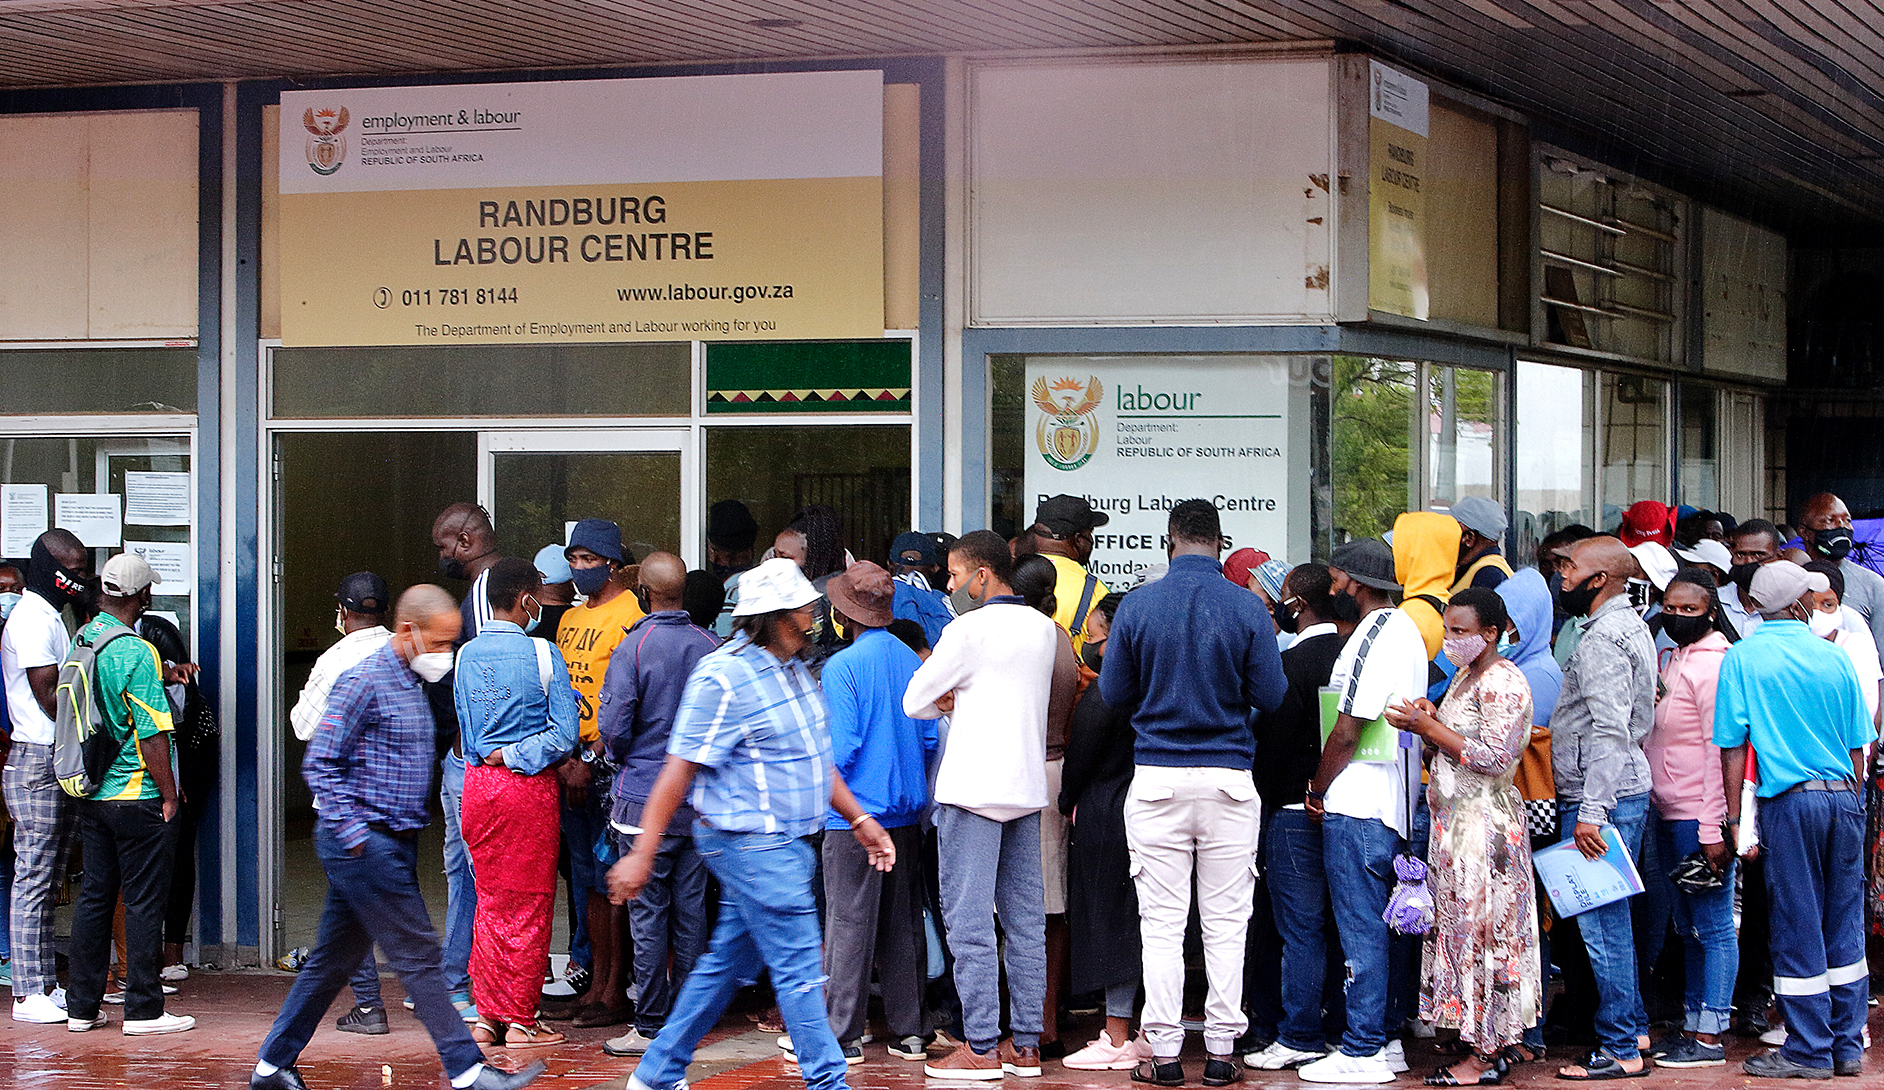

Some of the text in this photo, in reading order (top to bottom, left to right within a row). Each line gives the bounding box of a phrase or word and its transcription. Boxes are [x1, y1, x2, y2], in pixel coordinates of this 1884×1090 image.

[362, 109, 521, 131] employment & labour
[361, 145, 453, 156] Employment and Labour
[361, 154, 485, 166] REPUBLIC OF SOUTH AFRICA
[479, 195, 667, 229] RANDBURG
[433, 232, 715, 266] LABOUR CENTRE
[402, 286, 519, 306] 011 781 8144
[617, 283, 795, 305] www.labour.gov.za
[415, 318, 776, 338] The Department of Employment and Labour working for you
[1117, 384, 1202, 411] labour
[1117, 422, 1179, 434] Department:
[1117, 435, 1152, 445] Labour
[1117, 447, 1281, 458] REPUBLIC OF SOUTH AFRICA
[1213, 494, 1276, 511] Centre
[1092, 535, 1152, 550] FFICE
